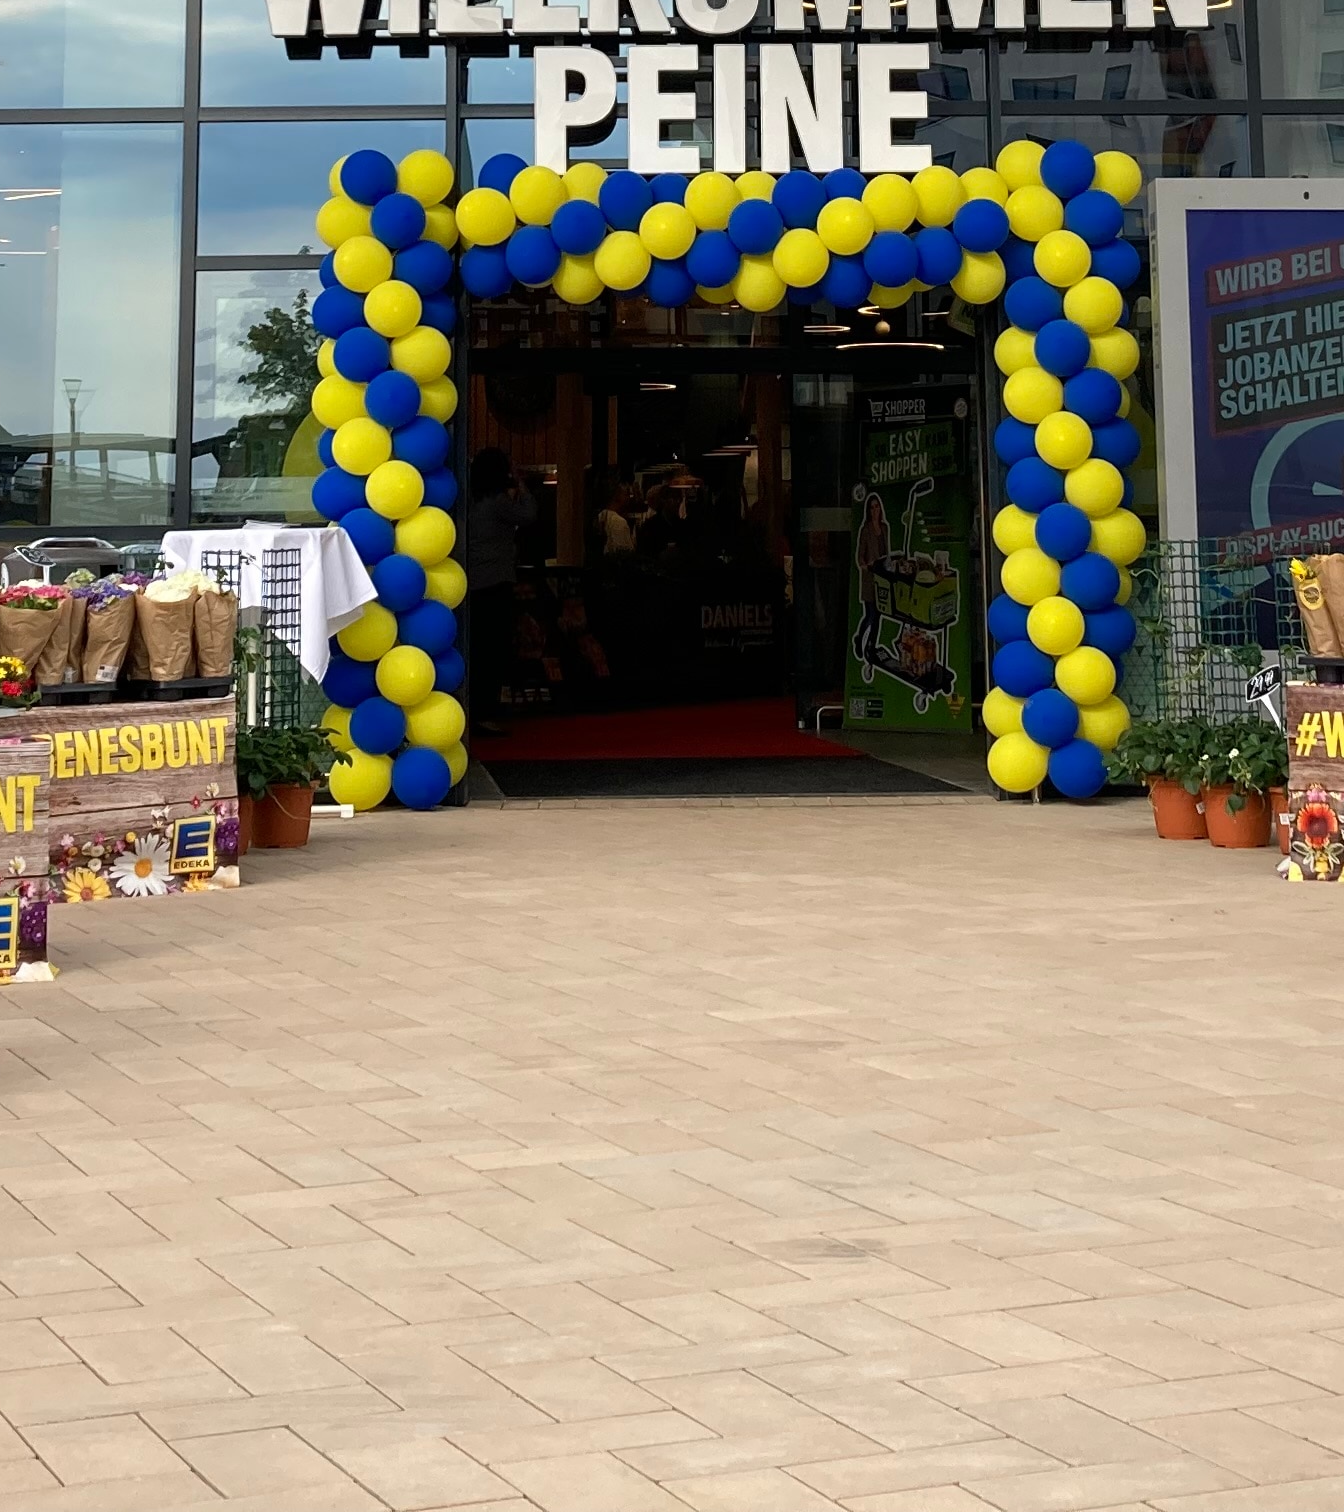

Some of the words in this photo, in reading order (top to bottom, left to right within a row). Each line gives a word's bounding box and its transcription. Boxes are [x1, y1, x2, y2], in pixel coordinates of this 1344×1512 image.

[533, 43, 933, 174] PEINE
[1215, 258, 1283, 296] WIRB
[1291, 249, 1332, 281] BEI
[1217, 310, 1298, 354] JETZT
[885, 399, 926, 416] SHOPPER
[889, 429, 922, 456] EASY
[871, 452, 928, 484] SHOPPEN
[701, 603, 773, 629] DANIELS
[173, 859, 211, 870] EDEKA
